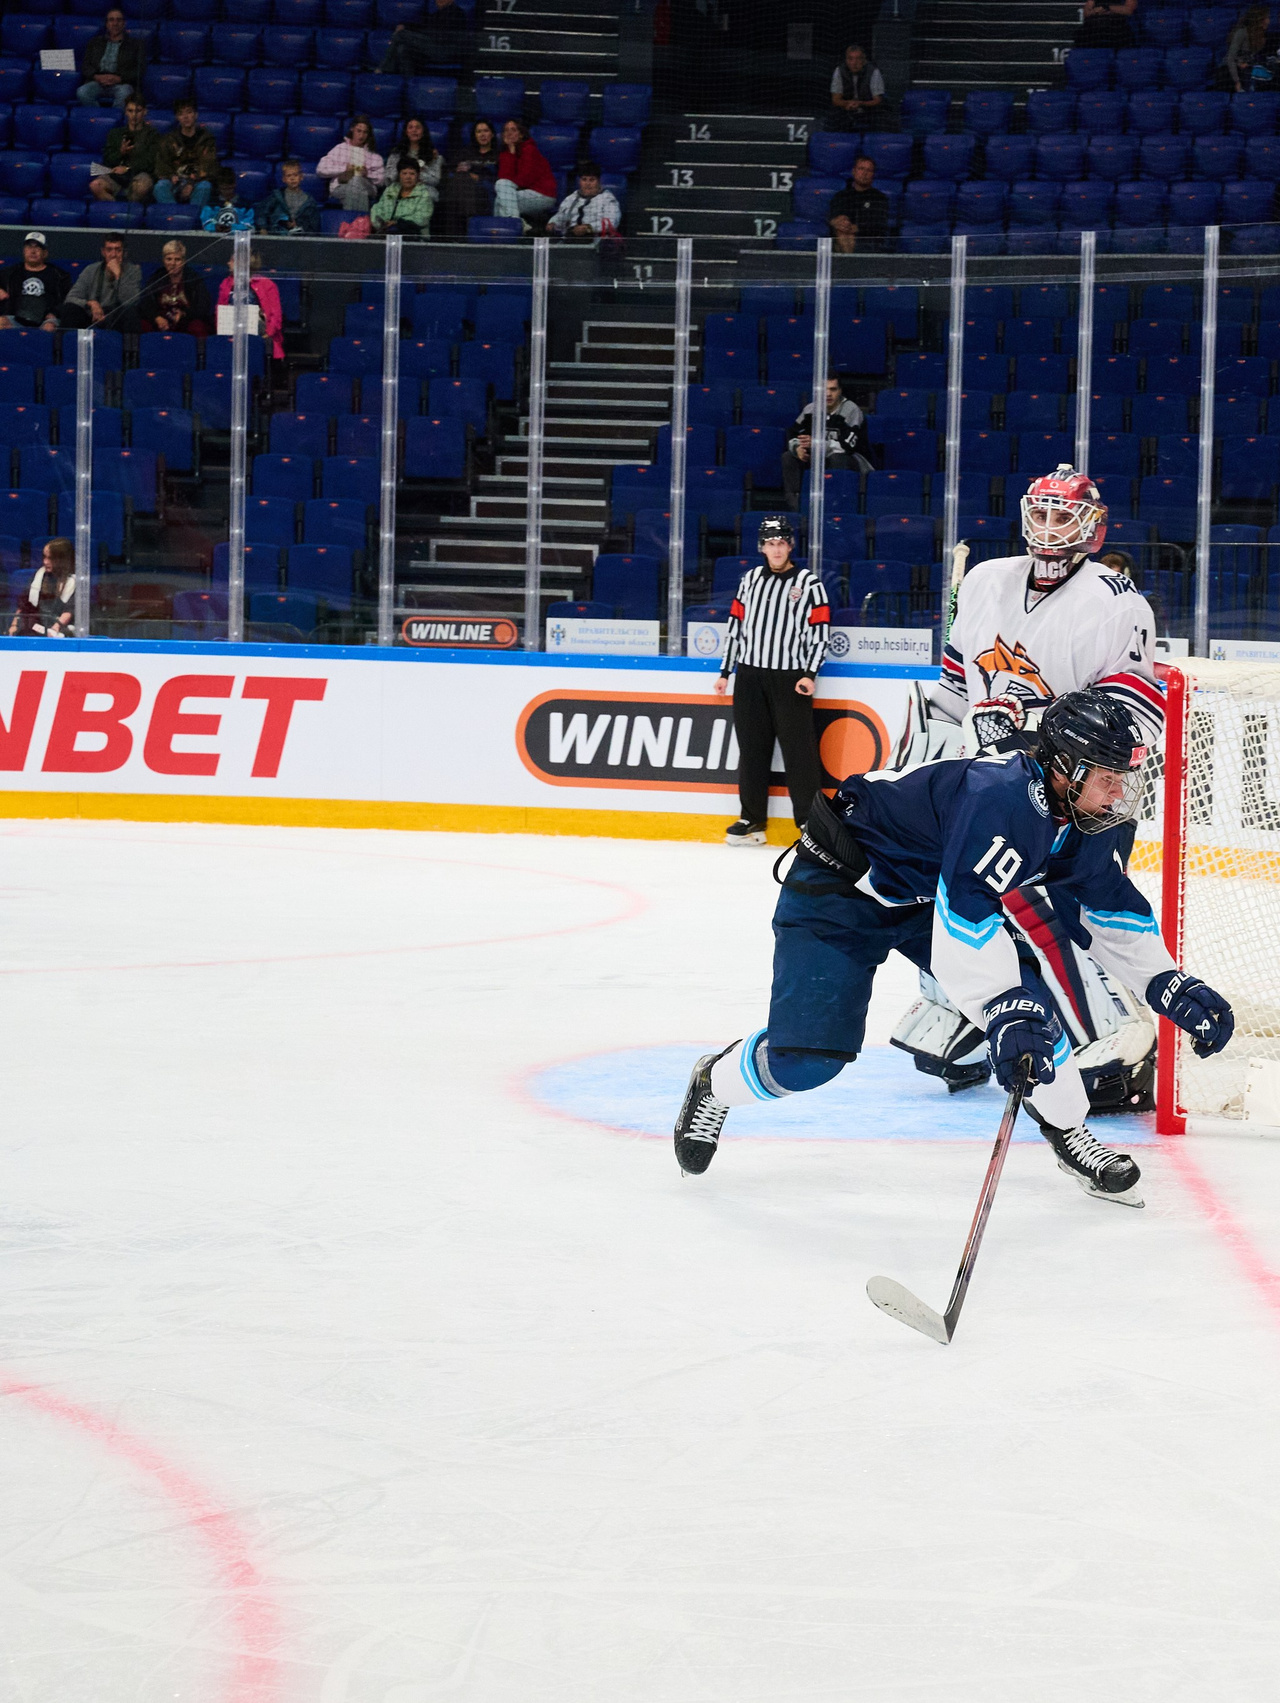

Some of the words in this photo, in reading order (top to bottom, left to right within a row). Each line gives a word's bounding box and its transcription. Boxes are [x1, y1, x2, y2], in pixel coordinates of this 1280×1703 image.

[488, 35, 511, 50] 16
[689, 123, 711, 140] 14
[787, 123, 808, 141] 14
[670, 169, 694, 187] 13
[770, 171, 793, 190] 13
[651, 216, 674, 235] 12
[754, 218, 777, 238] 12
[411, 622, 492, 641] WINLINE
[857, 637, 930, 654] shop.hcsibir.ru
[549, 712, 787, 773] WINLI
[1063, 728, 1090, 746] BAUER
[972, 835, 1023, 893] 19
